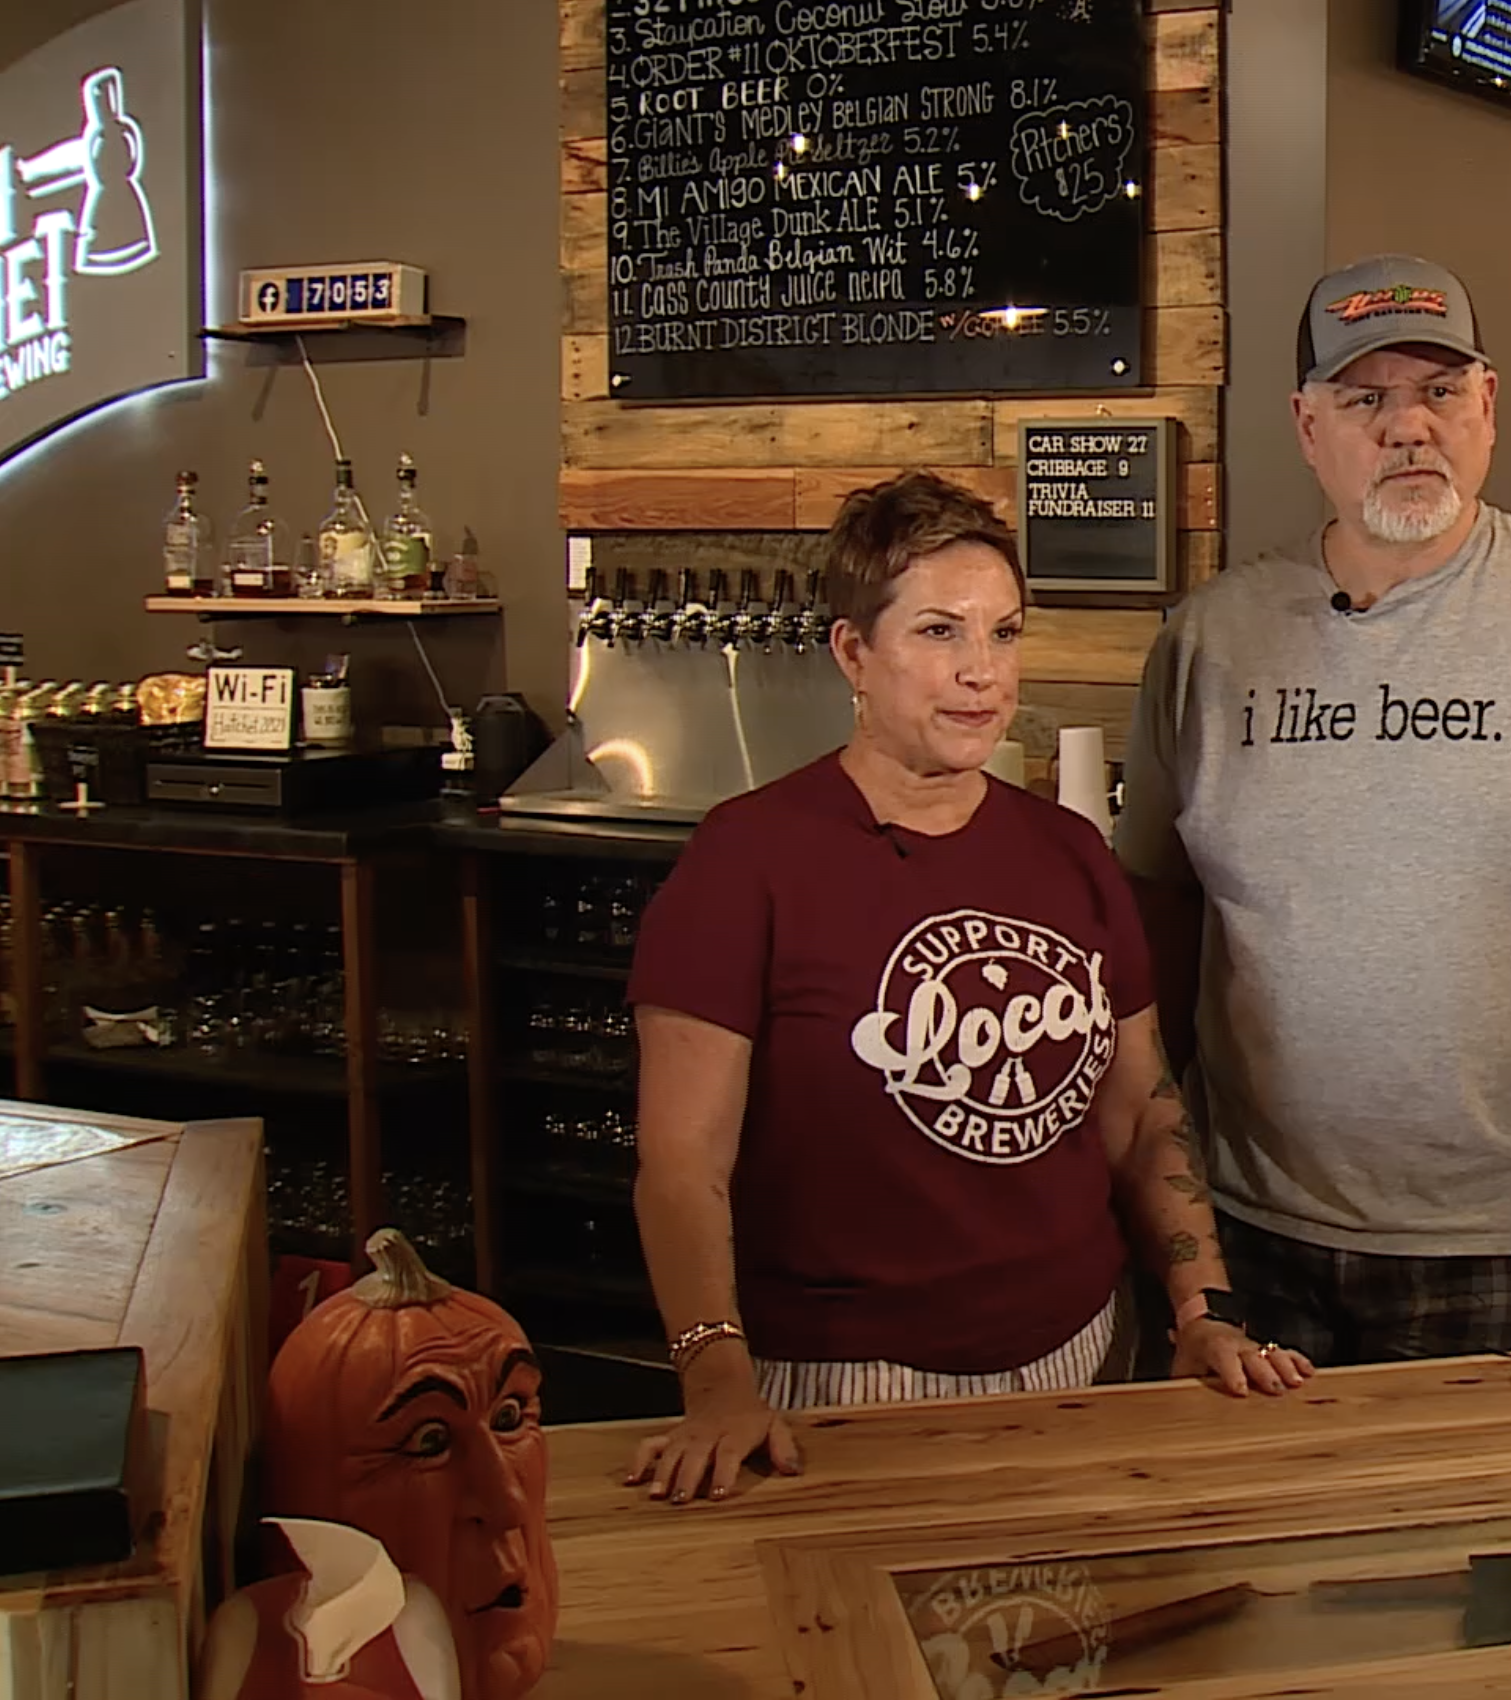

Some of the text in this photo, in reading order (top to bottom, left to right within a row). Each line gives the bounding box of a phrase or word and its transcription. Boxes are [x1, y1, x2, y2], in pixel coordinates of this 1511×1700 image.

[609, 28, 631, 54] 3.
[635, 11, 765, 48] Staycation
[631, 47, 725, 87] ORDER
[766, 21, 962, 73] OKTOBERFEST
[973, 20, 1030, 53] 5.4%
[610, 73, 844, 122] 5. ROOT BEER 0%
[611, 124, 634, 153] 6.
[921, 81, 994, 120] STRONG
[1010, 78, 1057, 109] 8.1%
[611, 157, 631, 184] 7.
[903, 126, 960, 154] 5.2%
[1021, 114, 1122, 173] Pitchers
[637, 186, 669, 220] MI
[774, 165, 881, 201] MEXICAN
[893, 163, 944, 195] ALE
[957, 161, 998, 192] 5%
[1055, 158, 1105, 205] $25
[612, 196, 948, 250] 9. The Village Dunk ALE 5.1%
[611, 255, 637, 285] 10.
[704, 244, 761, 277] Panda
[764, 239, 855, 274] Belgian
[863, 233, 908, 265] Wit
[922, 228, 979, 259] 4.6%
[924, 266, 974, 299] 5.8%
[636, 320, 717, 353] BURNT
[719, 312, 836, 349] DISTRICT
[842, 310, 935, 345] BLONDE
[1027, 459, 1130, 477] CRIBBAGE 9
[1028, 436, 1148, 453] CAR SHOW 27
[1028, 482, 1089, 500] TRIVIA
[1028, 500, 1156, 518] FUNDRAISER 11
[214, 673, 287, 704] Wi-Fi
[1241, 683, 1502, 747] i like beer.
[902, 919, 1078, 984] SUPPORT
[851, 950, 1112, 1101] Local
[933, 1035, 1111, 1154] BREWERIES
